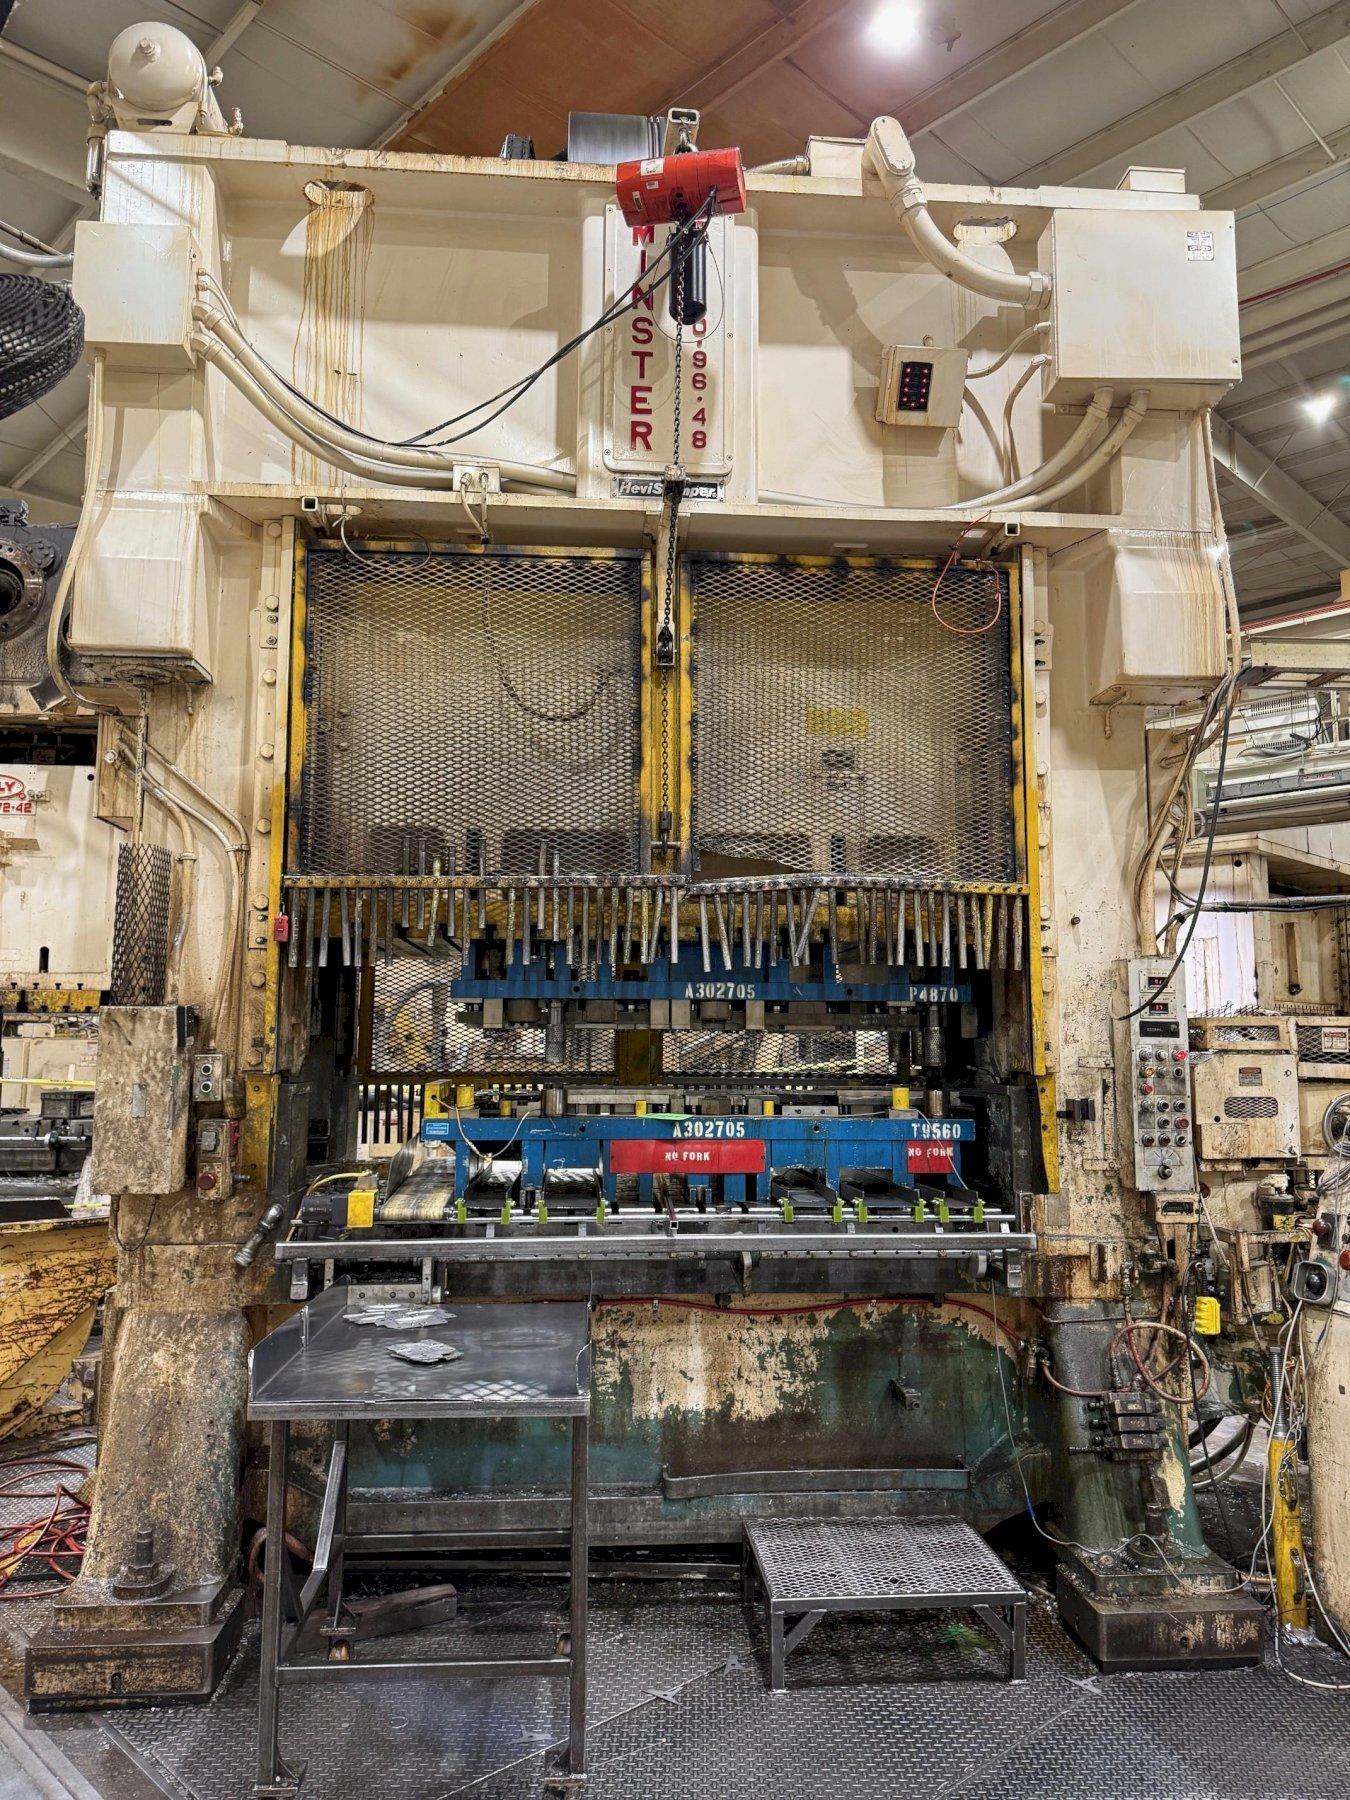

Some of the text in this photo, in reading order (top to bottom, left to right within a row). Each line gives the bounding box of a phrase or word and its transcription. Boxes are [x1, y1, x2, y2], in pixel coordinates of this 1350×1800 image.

[630, 225, 655, 452] MINSTER
[684, 983, 959, 1002] A302705 P4870
[672, 1121, 961, 1139] A302705 T9560
[683, 1151, 710, 1161] FORK
[907, 1147, 922, 1157] NO
